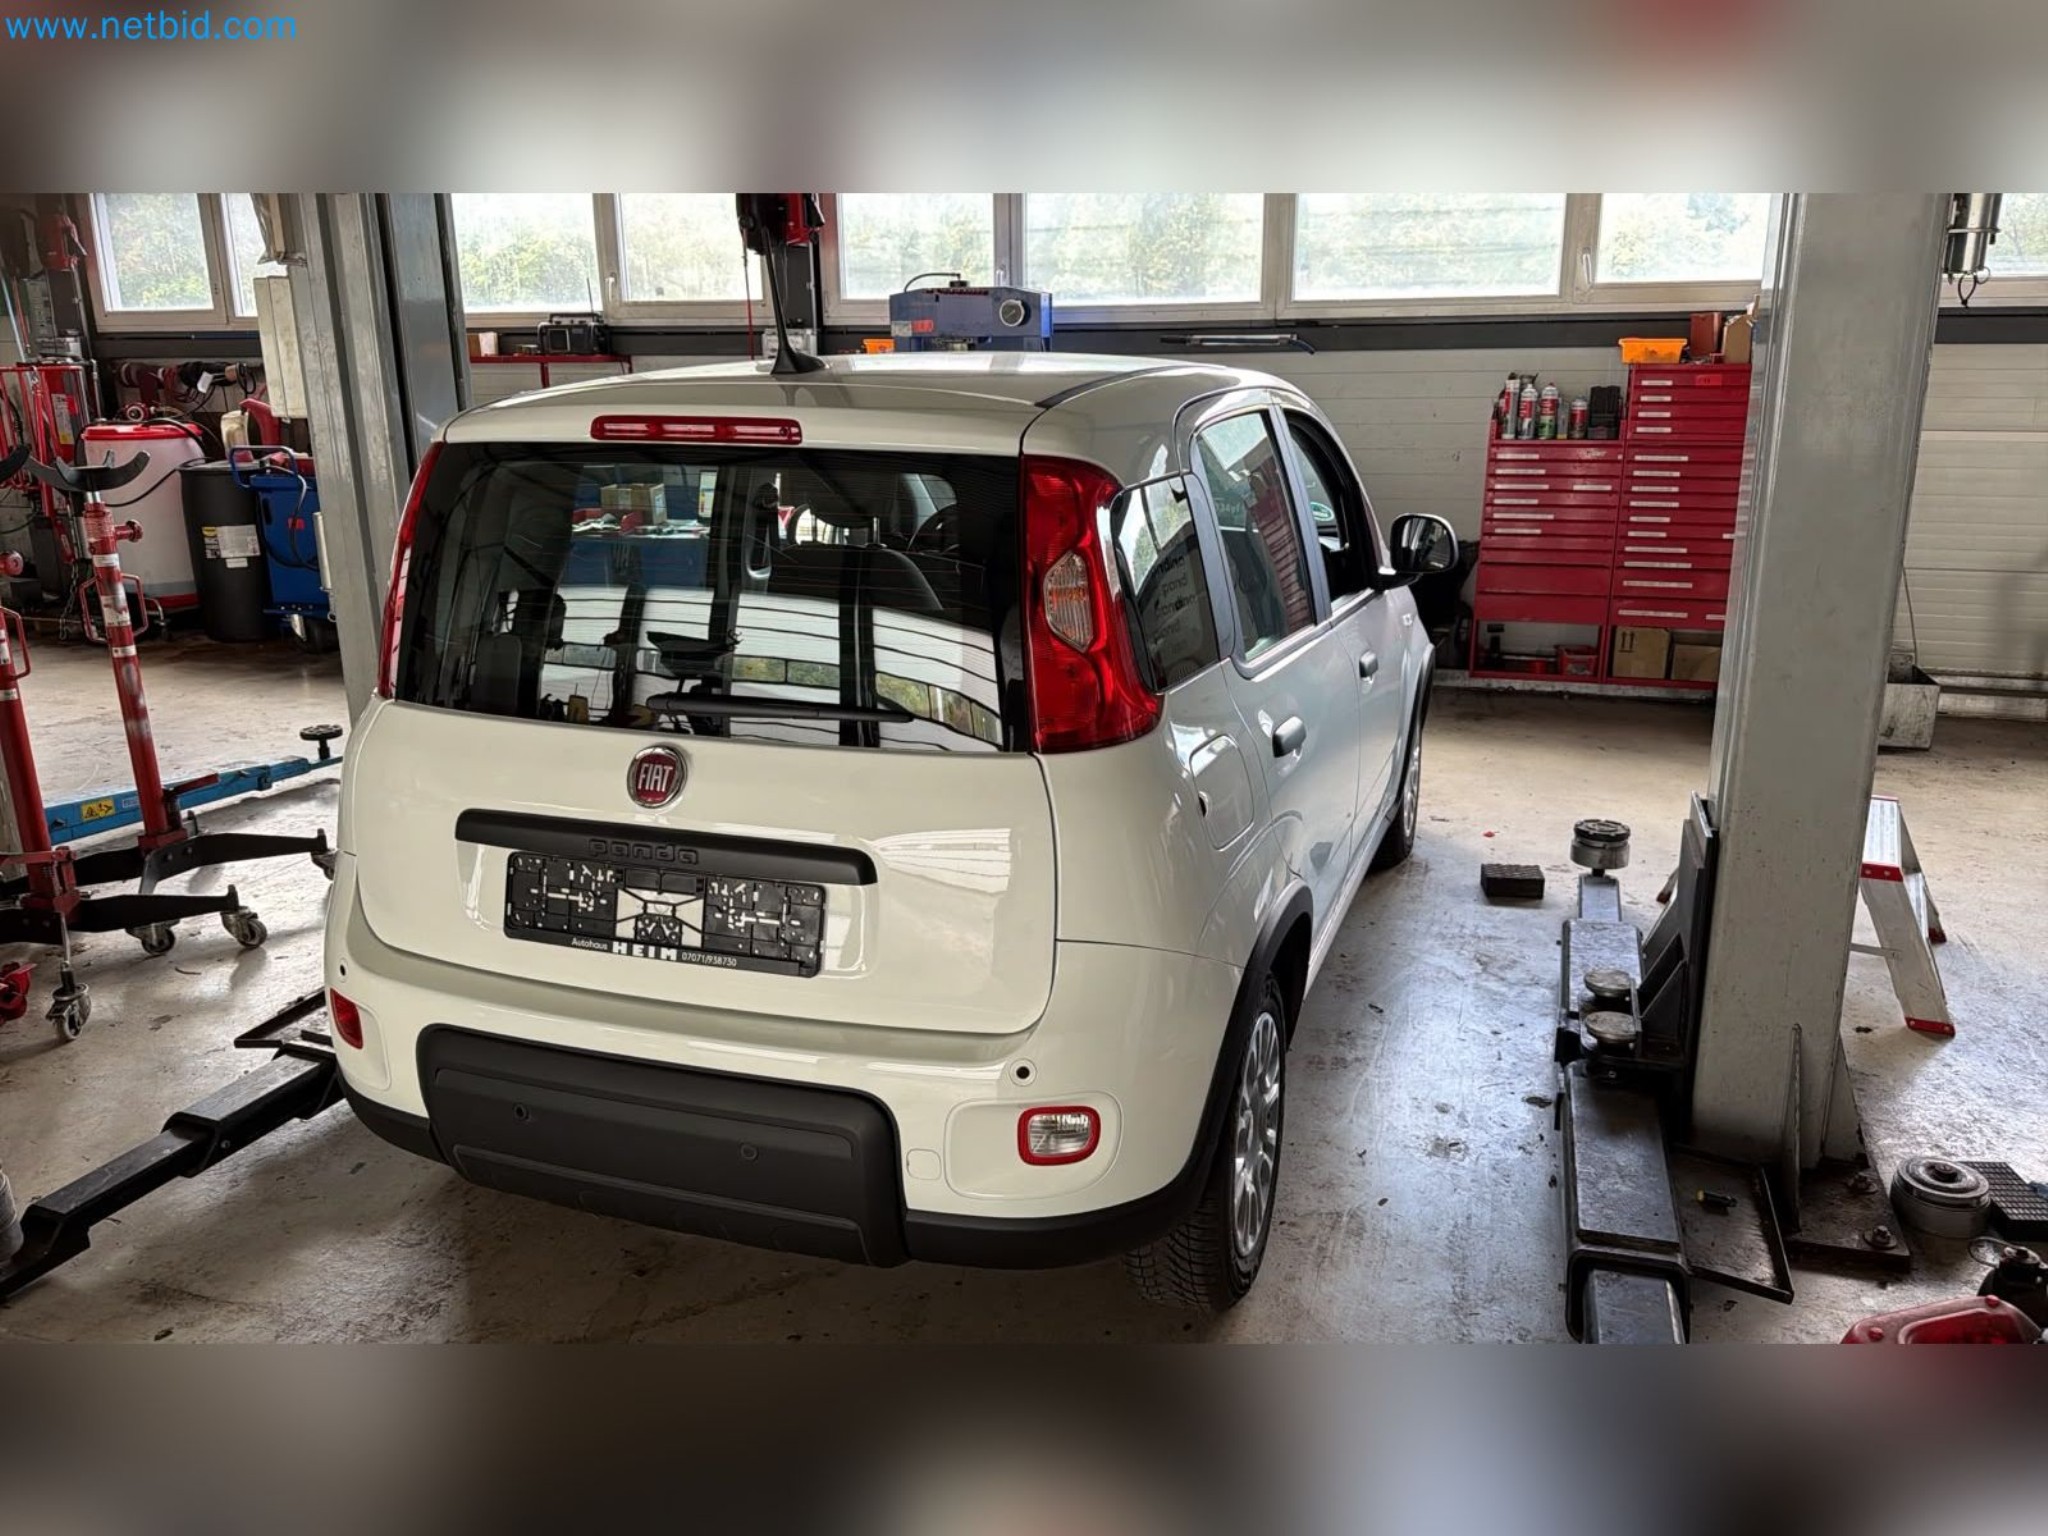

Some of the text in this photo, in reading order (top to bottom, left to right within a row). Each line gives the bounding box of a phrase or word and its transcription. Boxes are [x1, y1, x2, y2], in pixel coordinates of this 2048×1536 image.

[637, 763, 674, 792] FIAT
[588, 838, 699, 865] panda
[571, 937, 608, 950] Autohaus
[612, 941, 678, 961] HEIM
